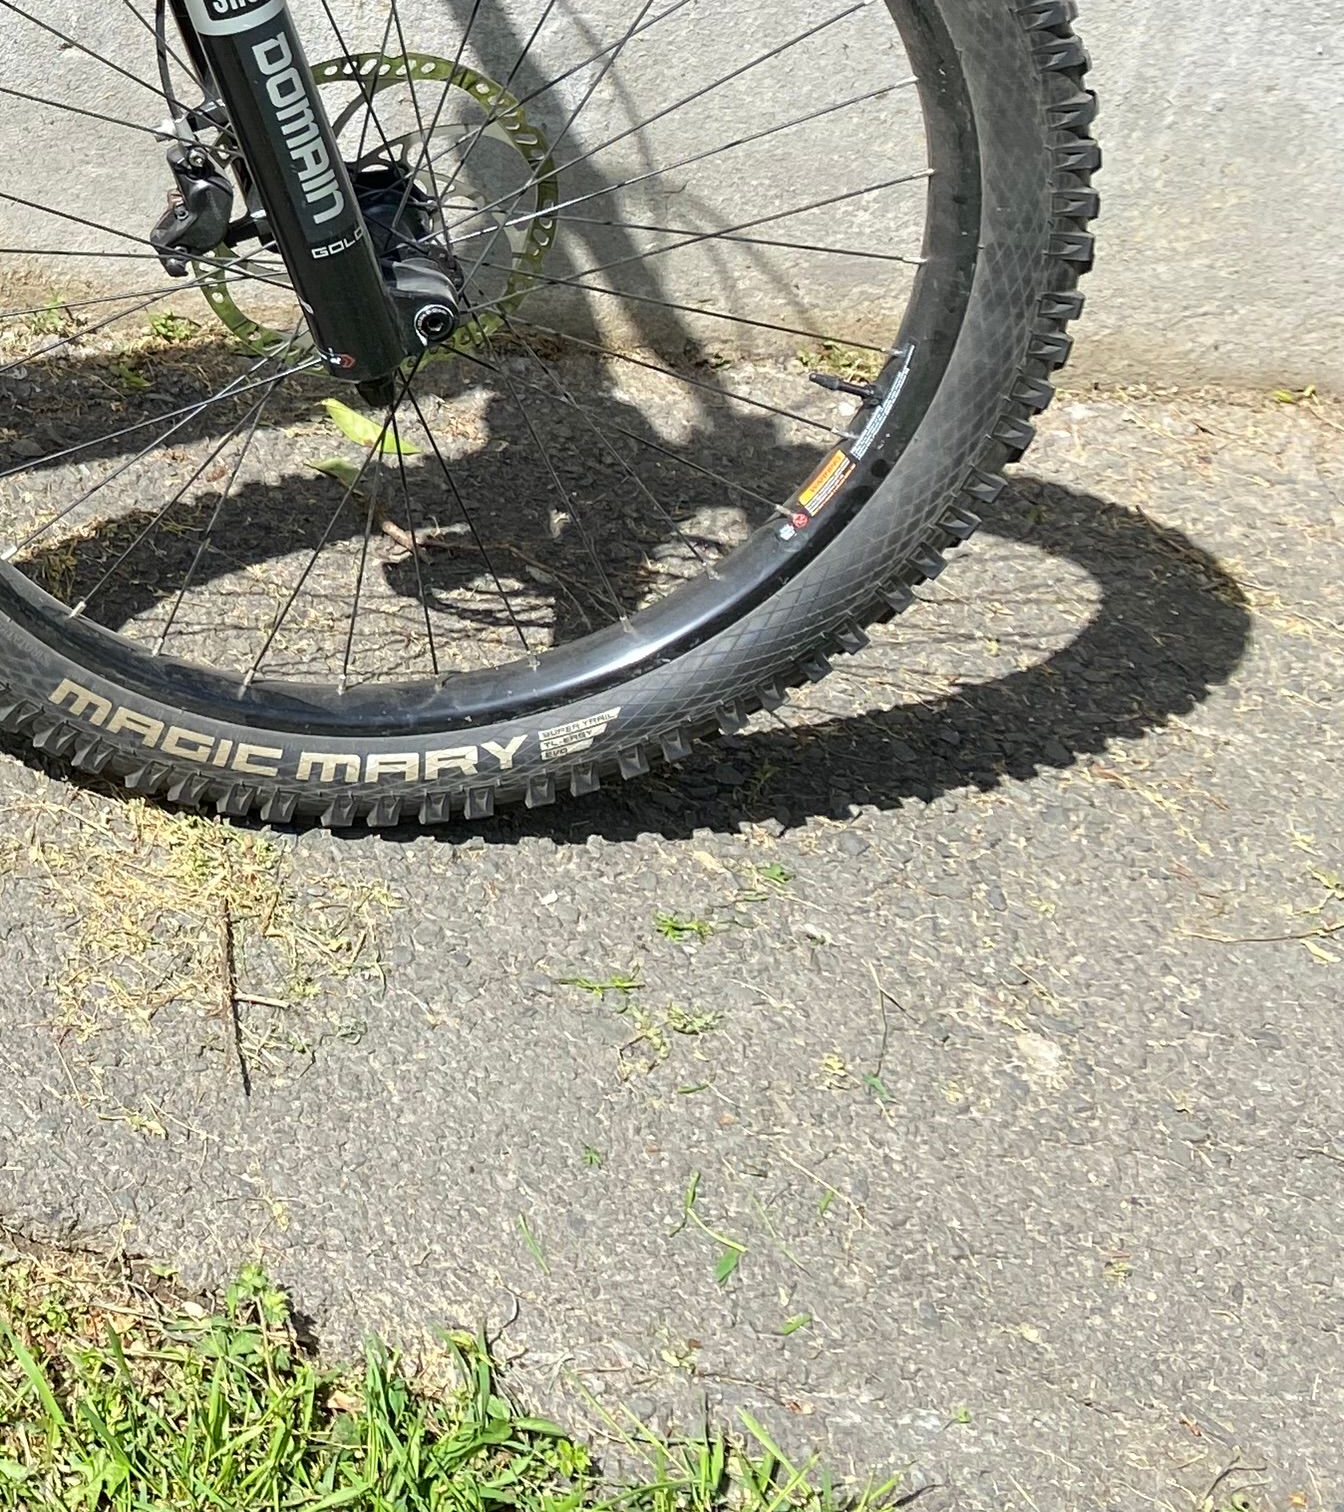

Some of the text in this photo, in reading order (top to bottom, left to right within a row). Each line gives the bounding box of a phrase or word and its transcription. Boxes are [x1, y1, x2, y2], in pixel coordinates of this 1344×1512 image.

[251, 31, 346, 225] DOMAIN
[47, 679, 529, 783] MAGIC MARY
